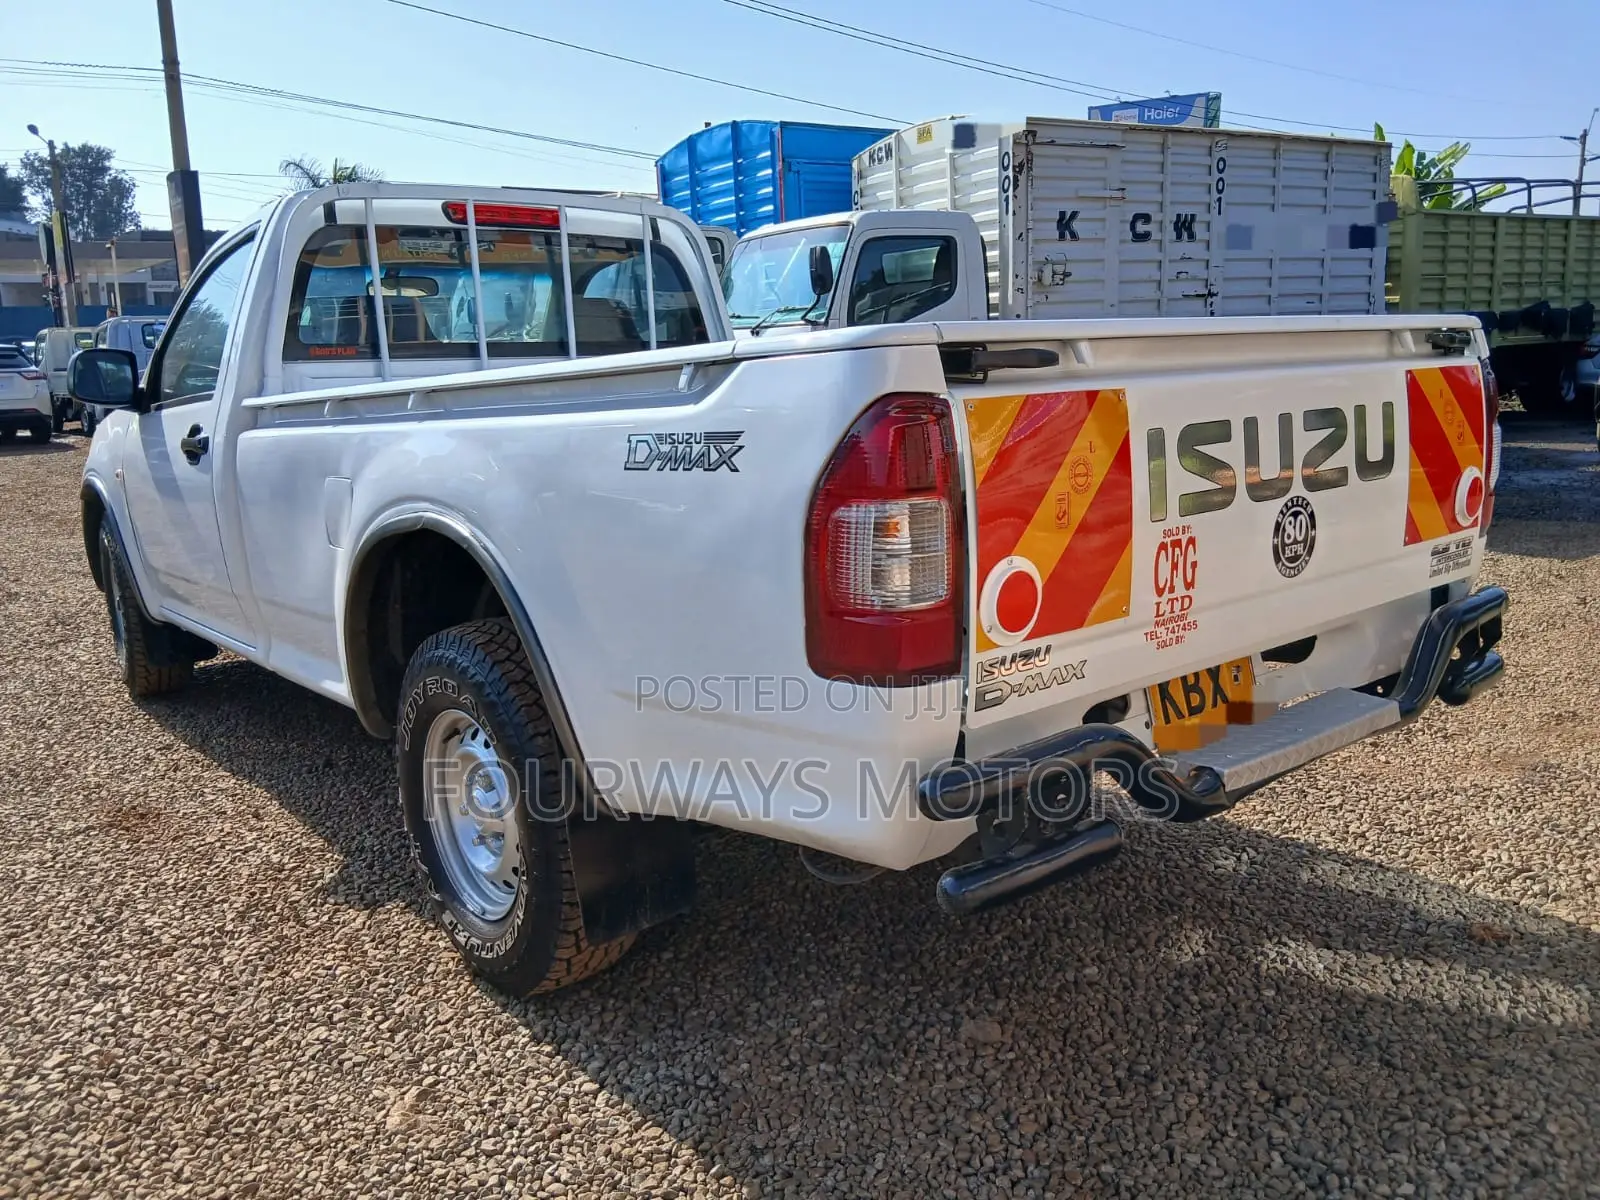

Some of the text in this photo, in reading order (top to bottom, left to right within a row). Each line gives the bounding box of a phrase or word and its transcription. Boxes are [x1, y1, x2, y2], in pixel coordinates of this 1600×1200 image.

[1144, 105, 1180, 121] Haier
[868, 142, 893, 168] KCW
[664, 432, 703, 445] ISUZU
[1147, 401, 1395, 523] ISUZU
[1162, 524, 1193, 539] SOLD BY:
[1284, 514, 1307, 544] 80
[1284, 543, 1304, 558] KPH
[1153, 535, 1198, 598] CFG
[1154, 594, 1193, 619] LTD
[1143, 620, 1198, 643] TEL: 747455
[1153, 611, 1189, 629] NAIROBI
[1156, 634, 1186, 650] SOLD BY:
[976, 644, 1053, 684] ISUZU
[974, 660, 1088, 712] D-MAX
[1157, 664, 1229, 725] KBX
